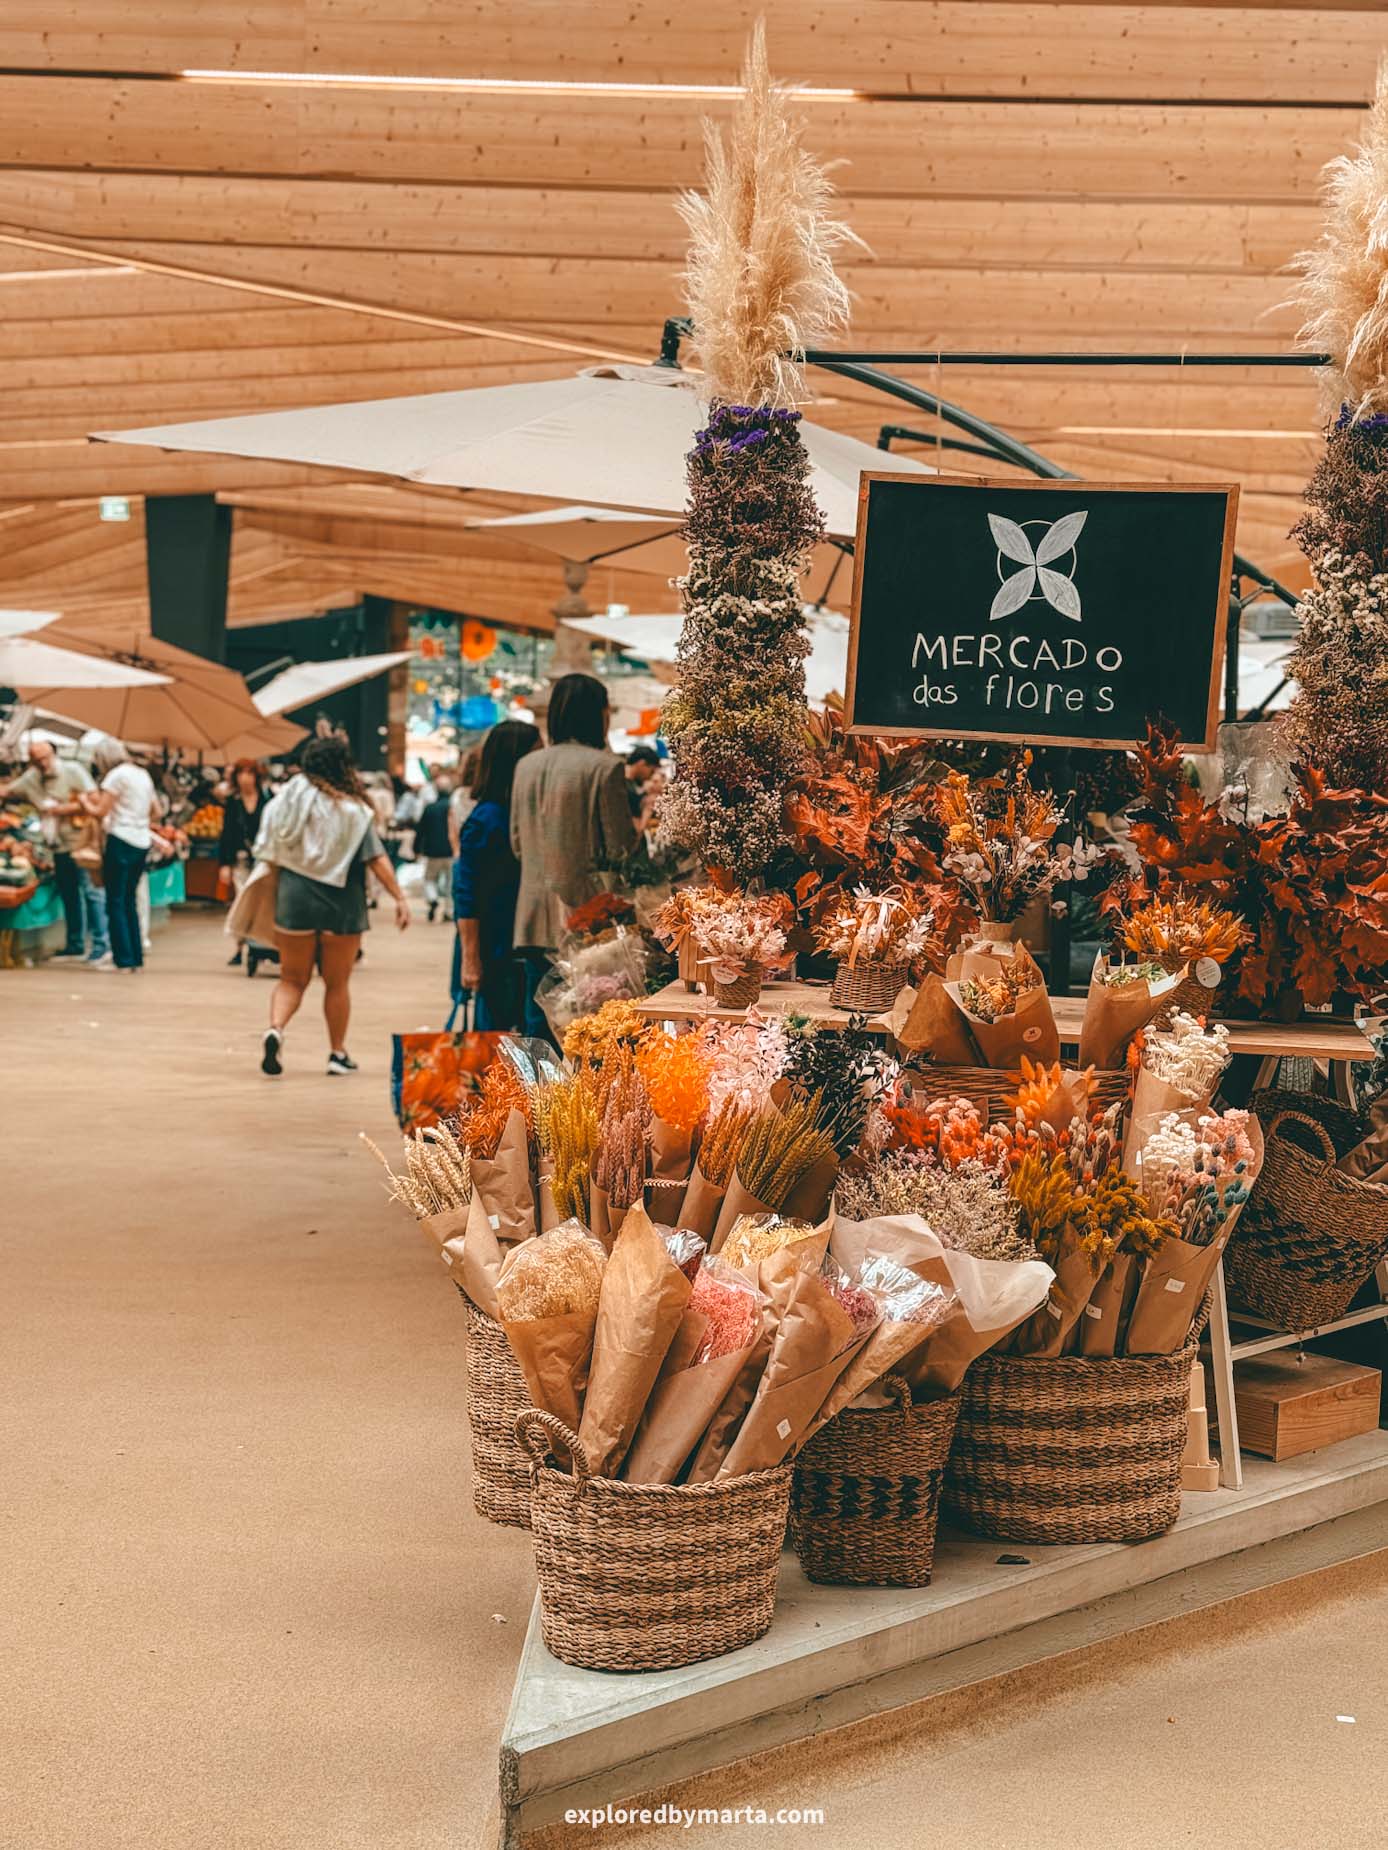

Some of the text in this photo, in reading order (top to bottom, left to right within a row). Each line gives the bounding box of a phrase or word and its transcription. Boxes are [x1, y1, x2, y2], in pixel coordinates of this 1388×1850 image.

[911, 632, 1123, 672] MERCADO
[912, 674, 1115, 714] das flores
